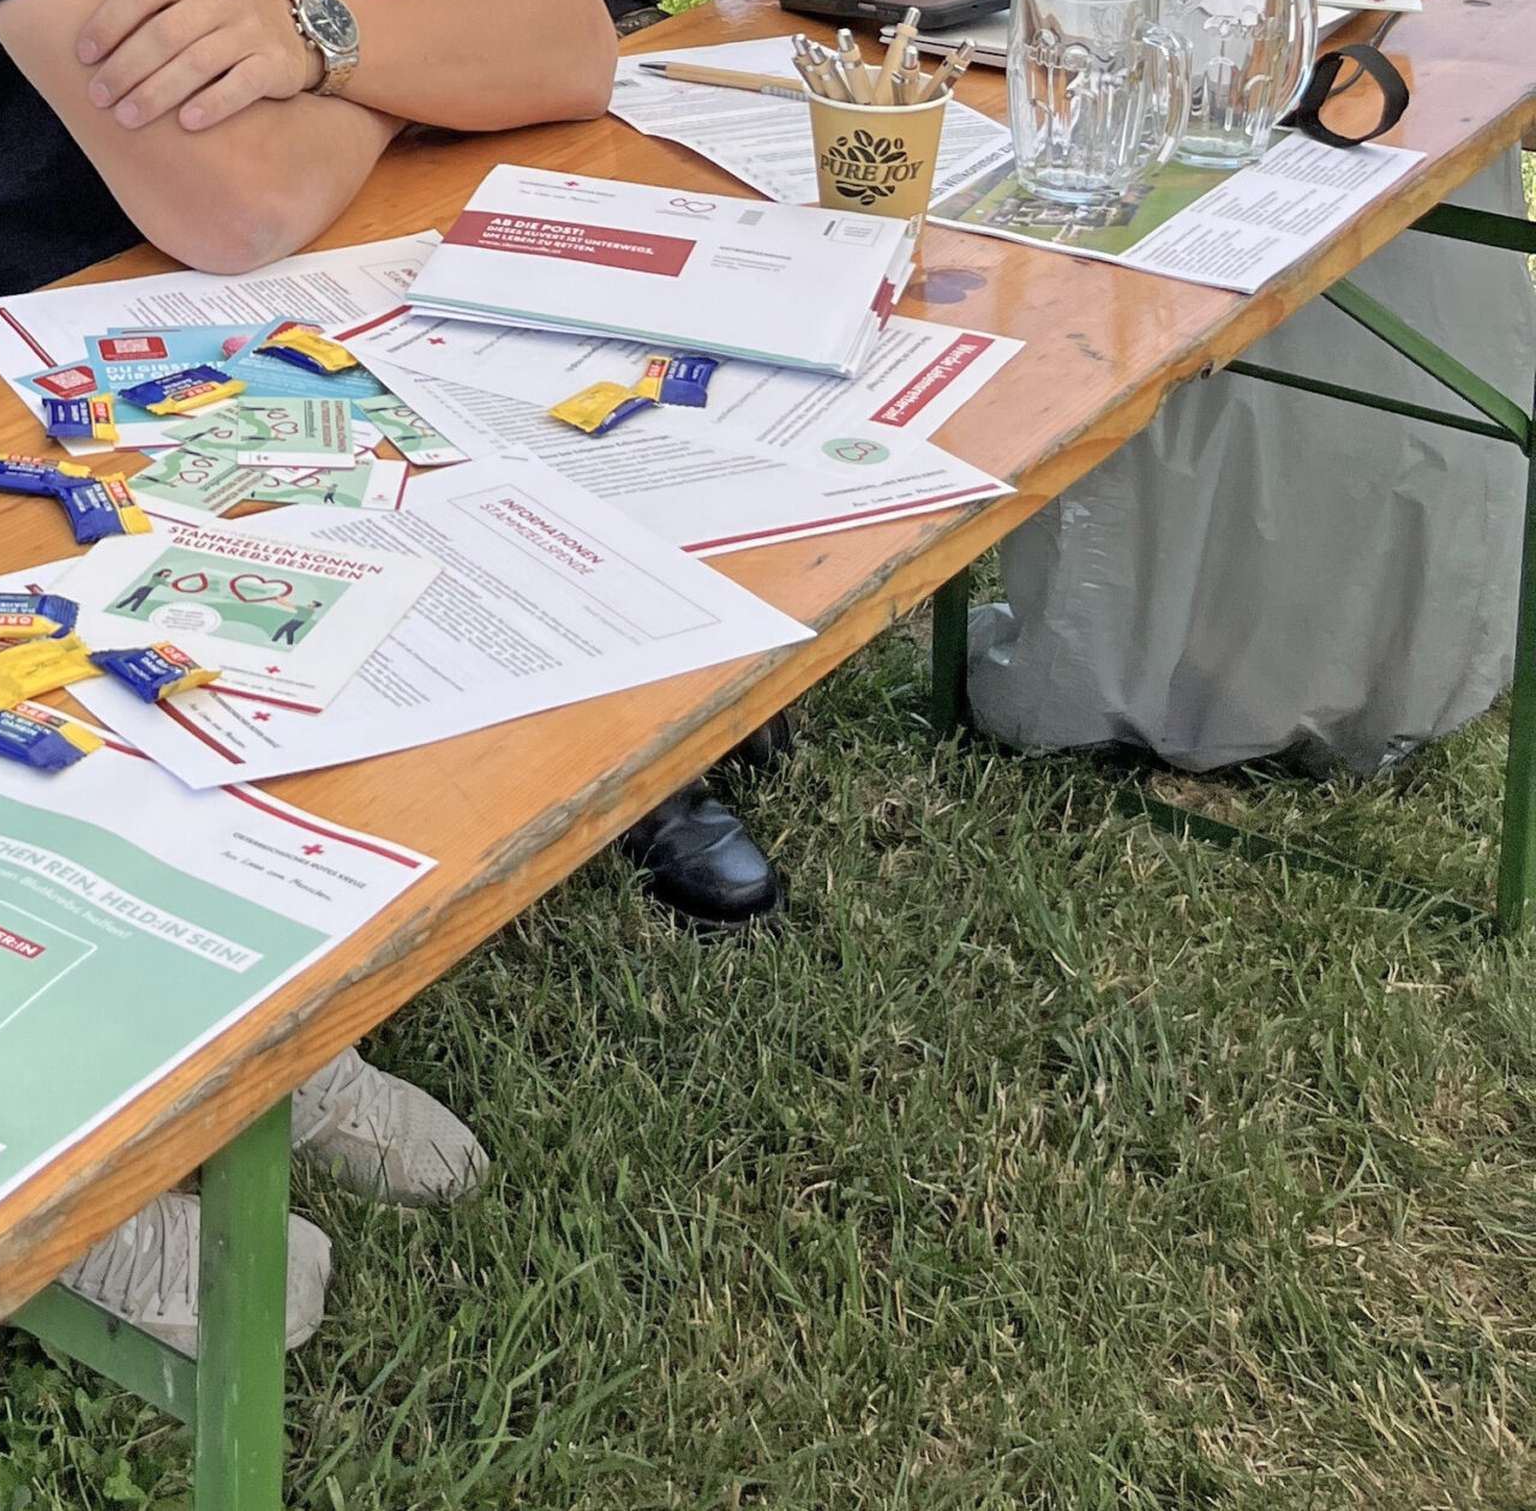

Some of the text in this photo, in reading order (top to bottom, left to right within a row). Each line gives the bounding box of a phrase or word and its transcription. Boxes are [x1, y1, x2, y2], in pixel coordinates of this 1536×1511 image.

[819, 152, 924, 185] PURE JOY
[490, 218, 512, 228] AB
[514, 220, 540, 230] DIE
[167, 524, 298, 557] STAMMZELLEN
[498, 498, 605, 565] INFORMATIONEN
[172, 535, 365, 580] BLUTKREBS BESIEGEN
[189, 931, 251, 968] SEIN!
